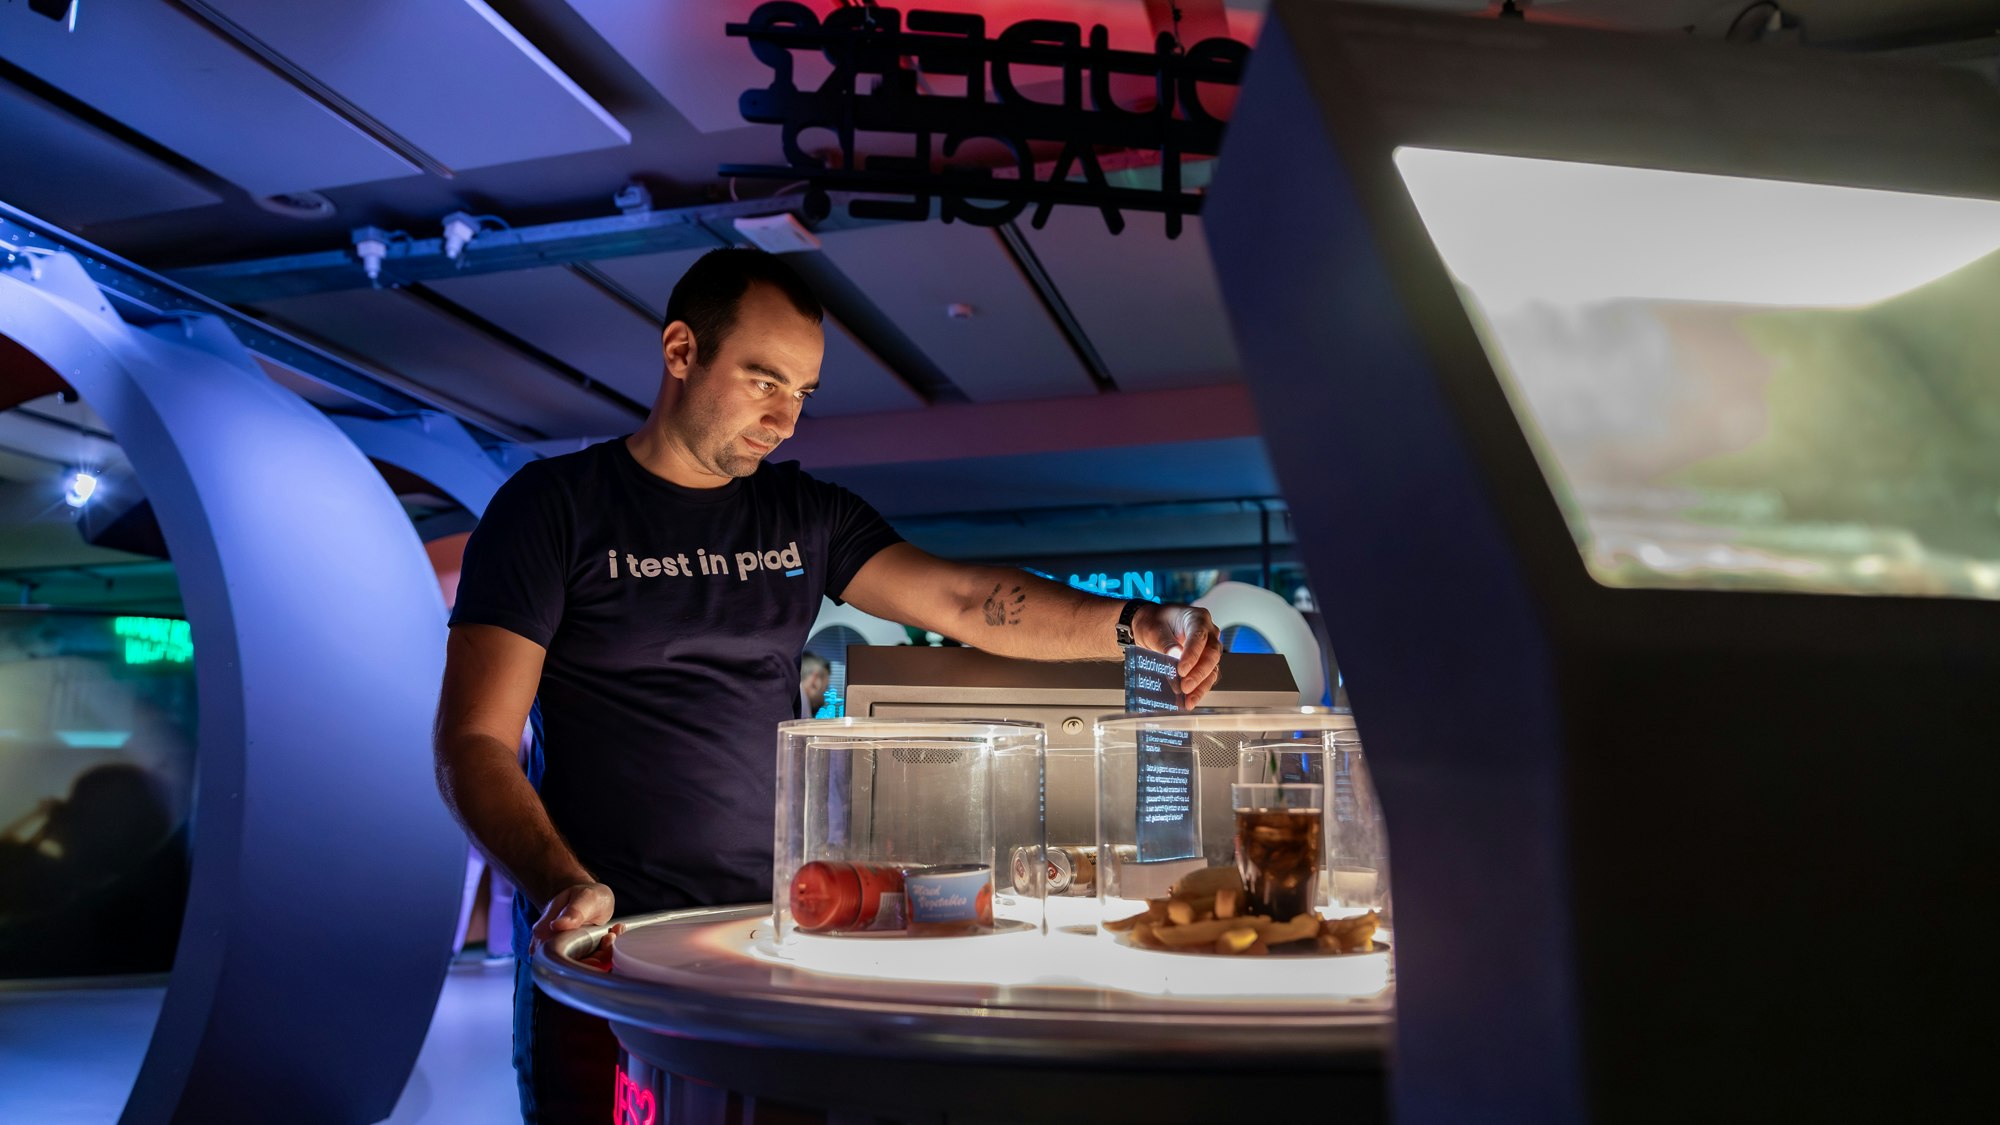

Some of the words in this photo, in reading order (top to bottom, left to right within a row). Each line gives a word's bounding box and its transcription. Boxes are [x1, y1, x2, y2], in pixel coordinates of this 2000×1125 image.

[608, 549, 618, 579] i
[626, 553, 693, 578] test
[696, 548, 729, 576] in
[917, 893, 968, 911] Vegetables
